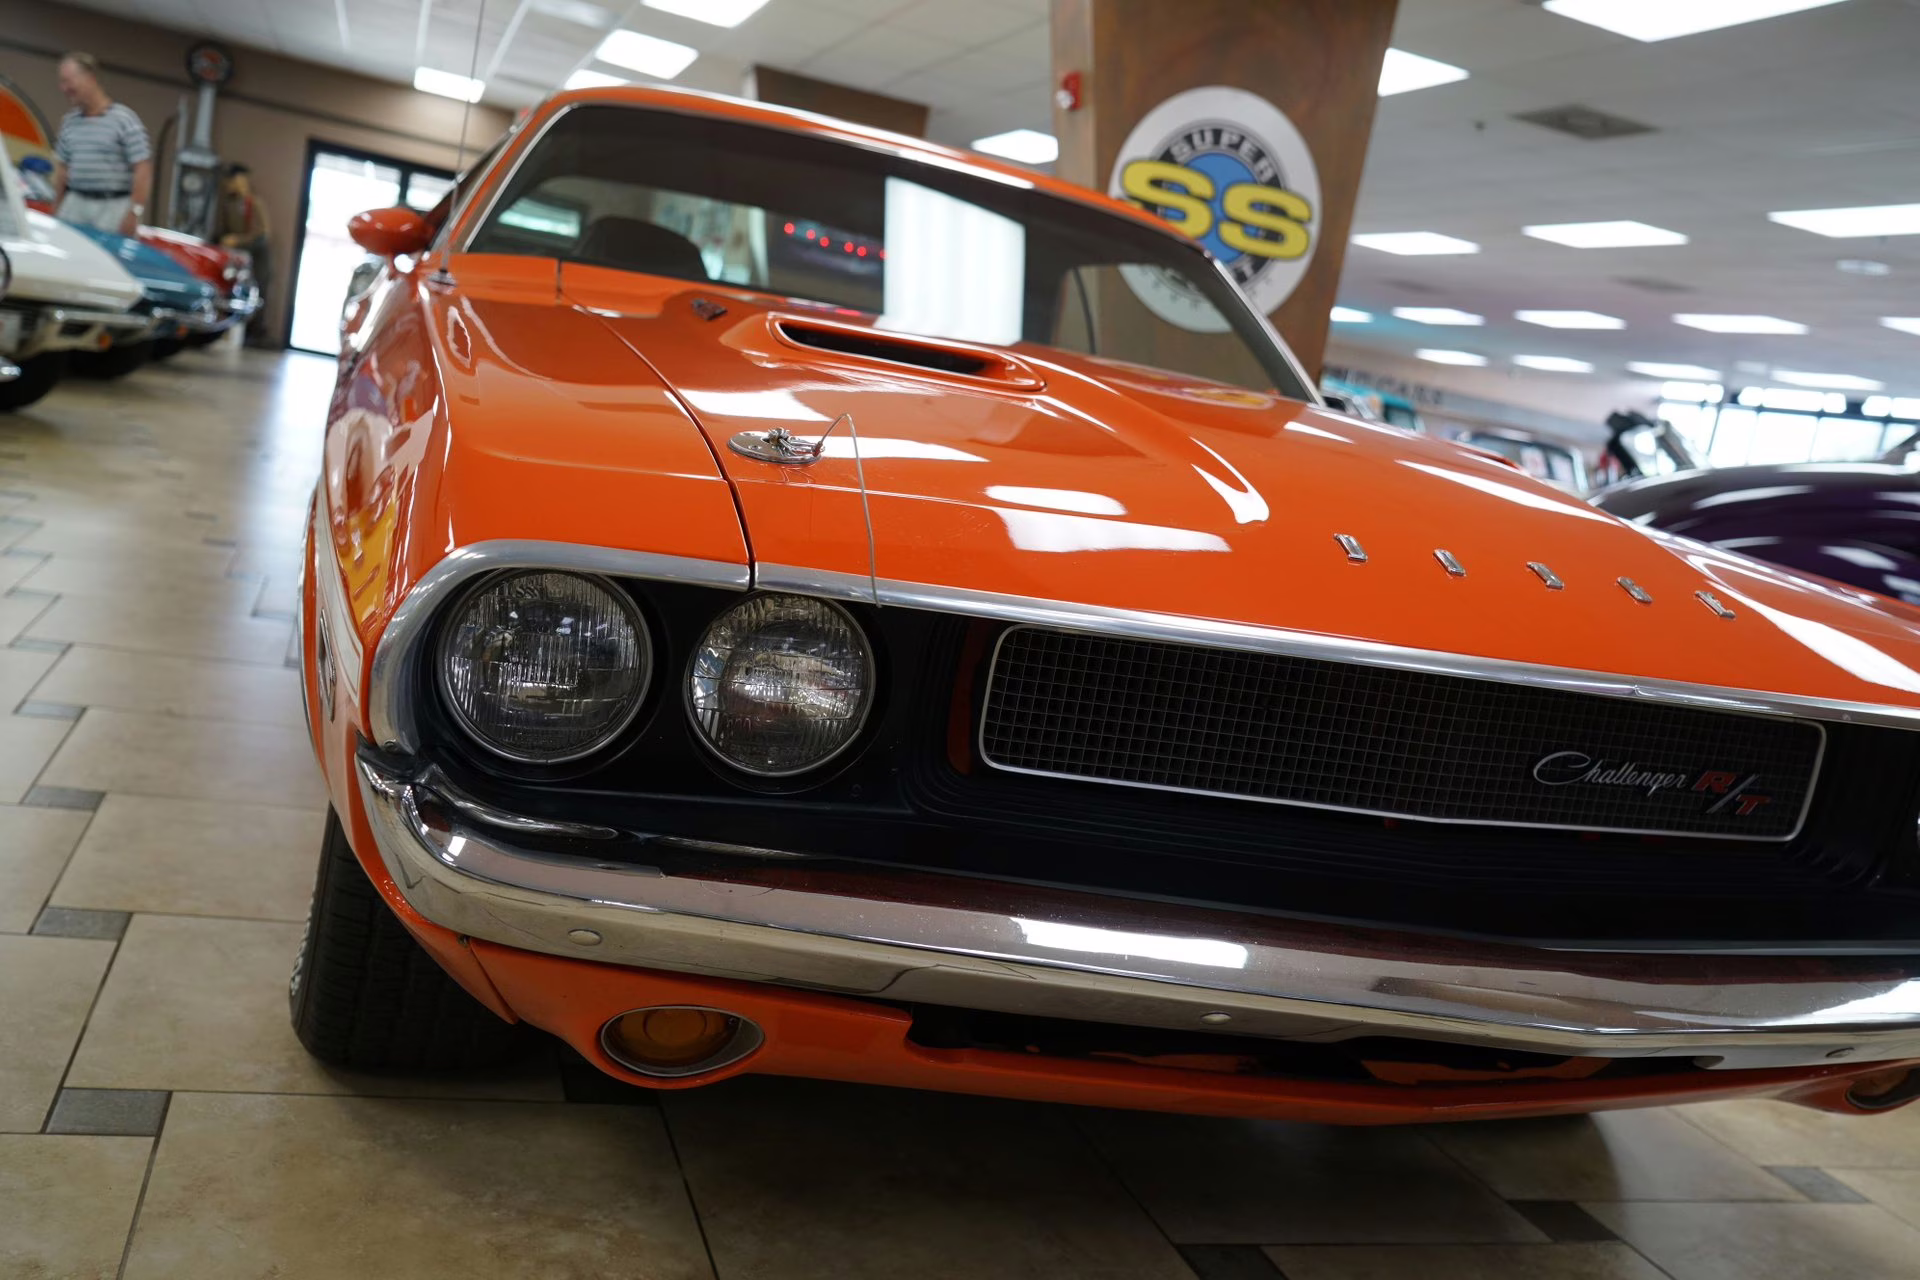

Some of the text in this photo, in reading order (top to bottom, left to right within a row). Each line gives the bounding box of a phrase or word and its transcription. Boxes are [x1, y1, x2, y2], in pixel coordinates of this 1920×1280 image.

[1169, 128, 1275, 183] SUPER
[1119, 159, 1313, 261] SS
[1533, 750, 1772, 815] Challenger R/T
